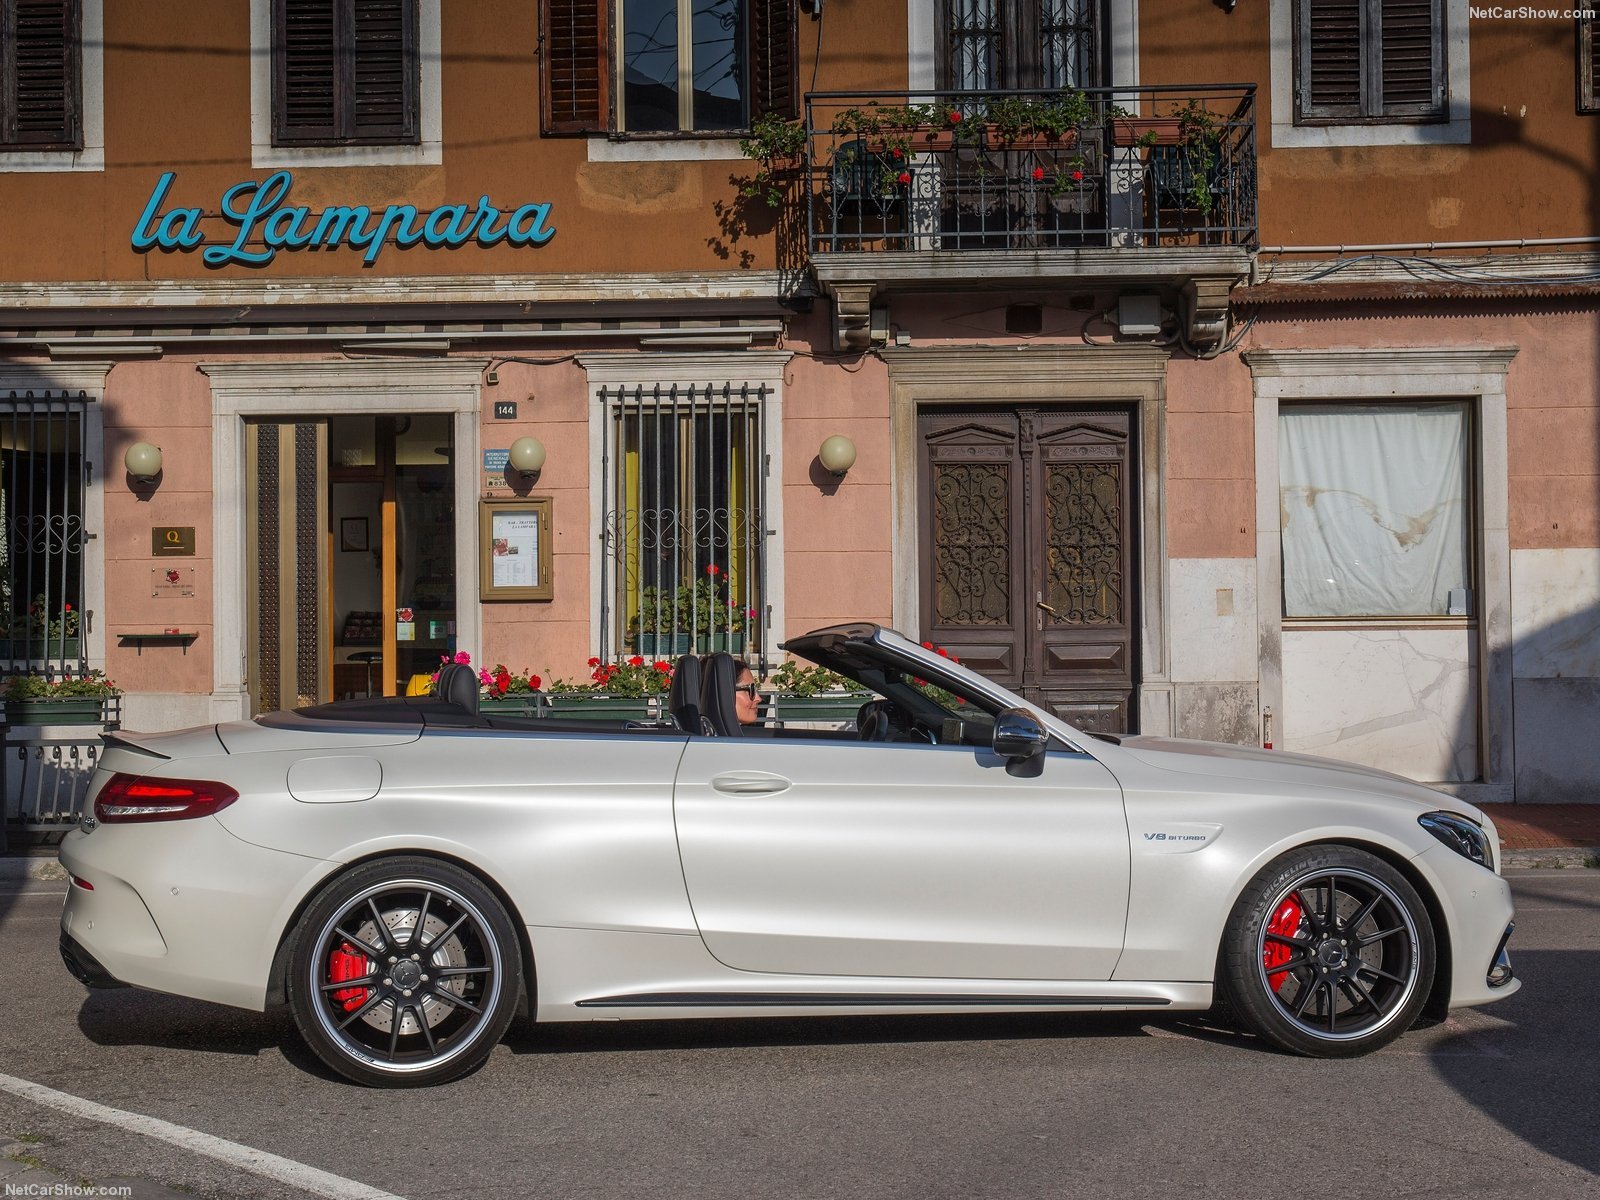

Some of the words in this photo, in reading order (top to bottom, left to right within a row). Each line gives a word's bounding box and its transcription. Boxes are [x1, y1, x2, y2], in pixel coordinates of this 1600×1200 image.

[131, 171, 204, 250] la
[202, 170, 557, 265] Lampara
[498, 405, 513, 415] 144
[166, 530, 180, 543] Q
[1143, 833, 1167, 841] V8
[1262, 860, 1308, 900] MICHELIN
